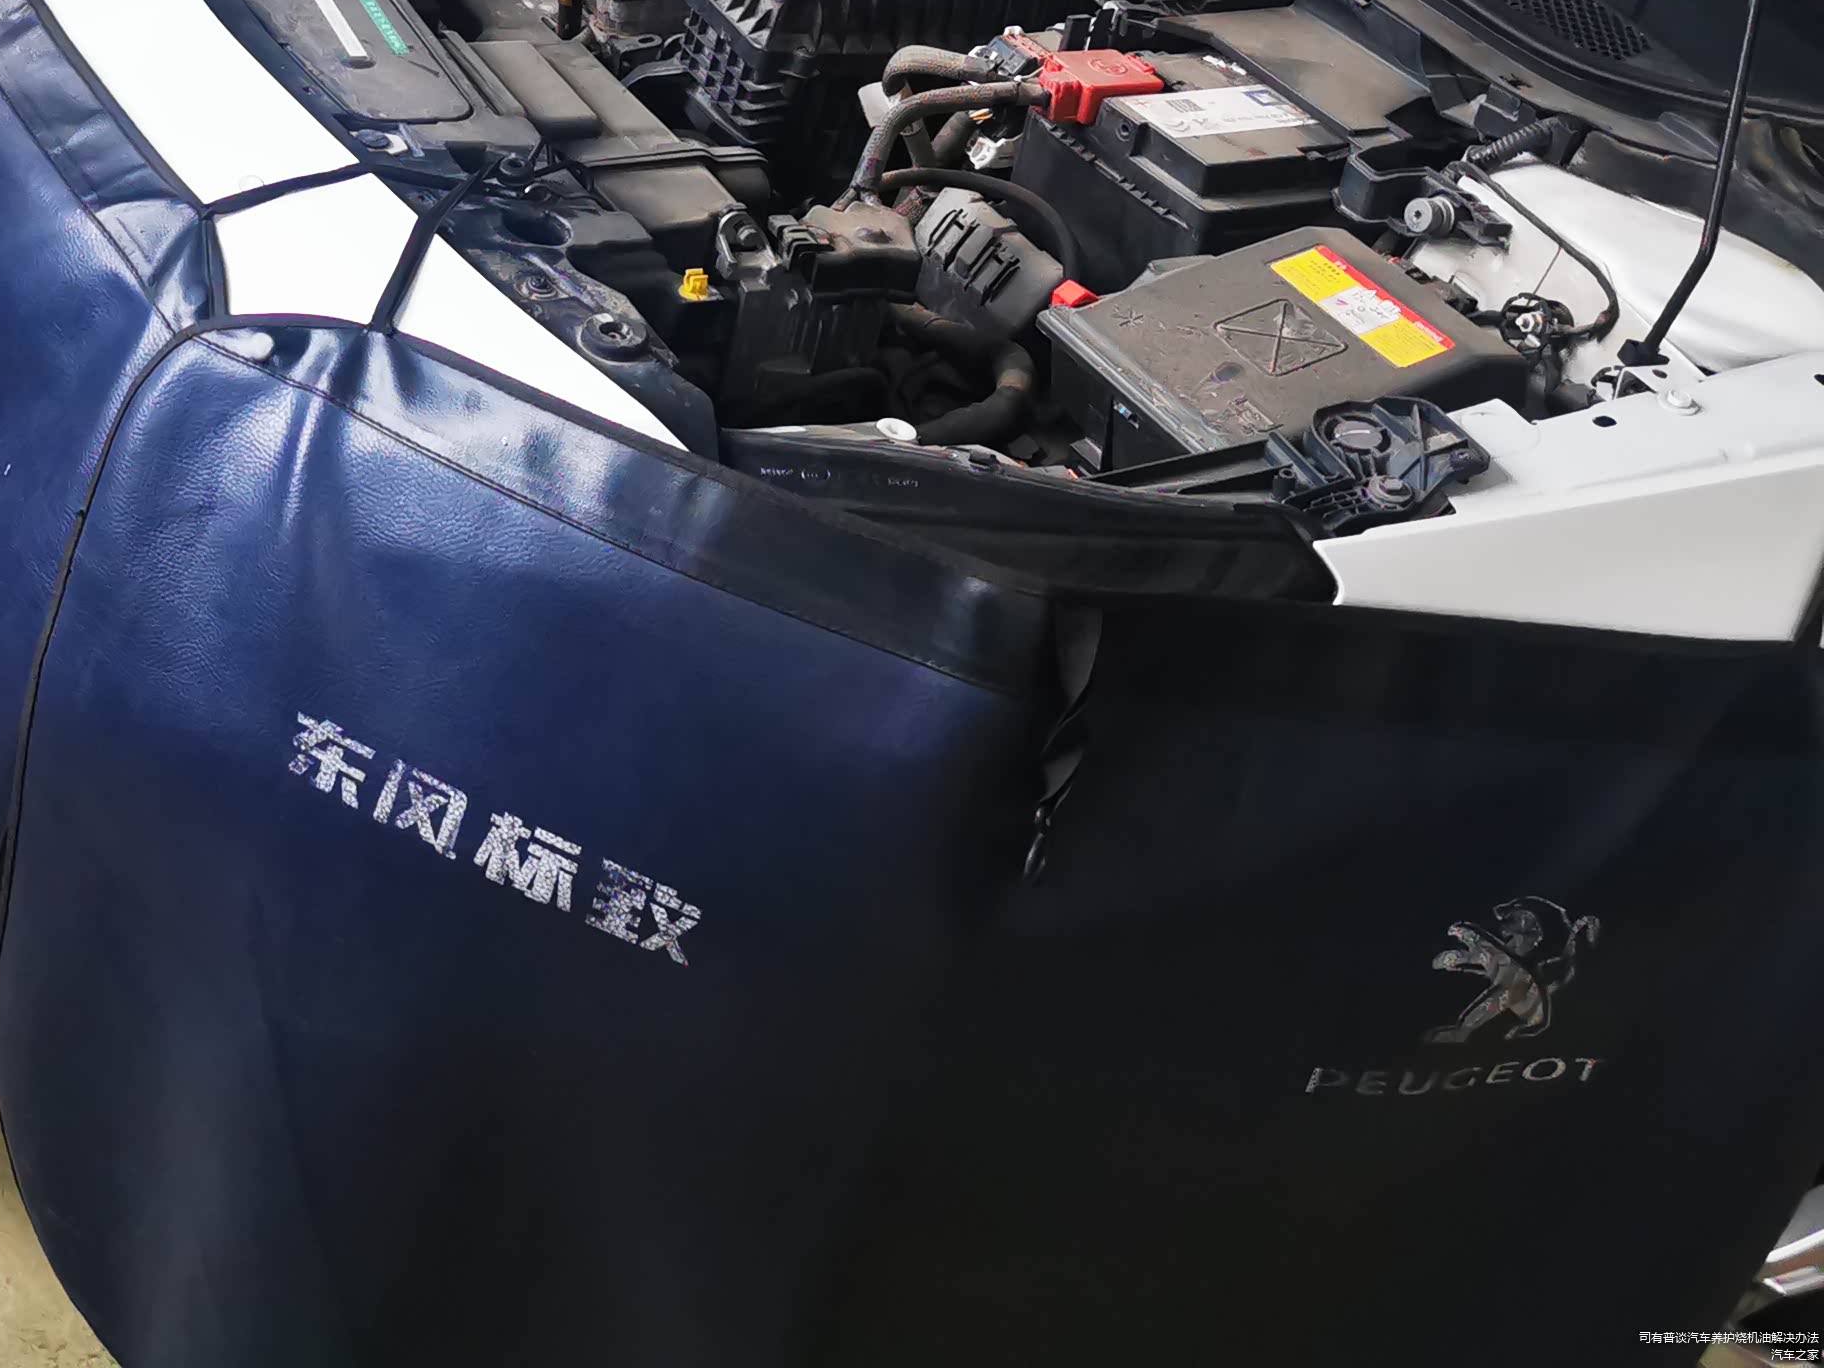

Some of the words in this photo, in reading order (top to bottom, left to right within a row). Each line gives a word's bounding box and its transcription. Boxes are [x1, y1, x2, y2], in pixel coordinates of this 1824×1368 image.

[287, 710, 703, 967] 东风标致
[1304, 1057, 1602, 1096] PEUGEOT
